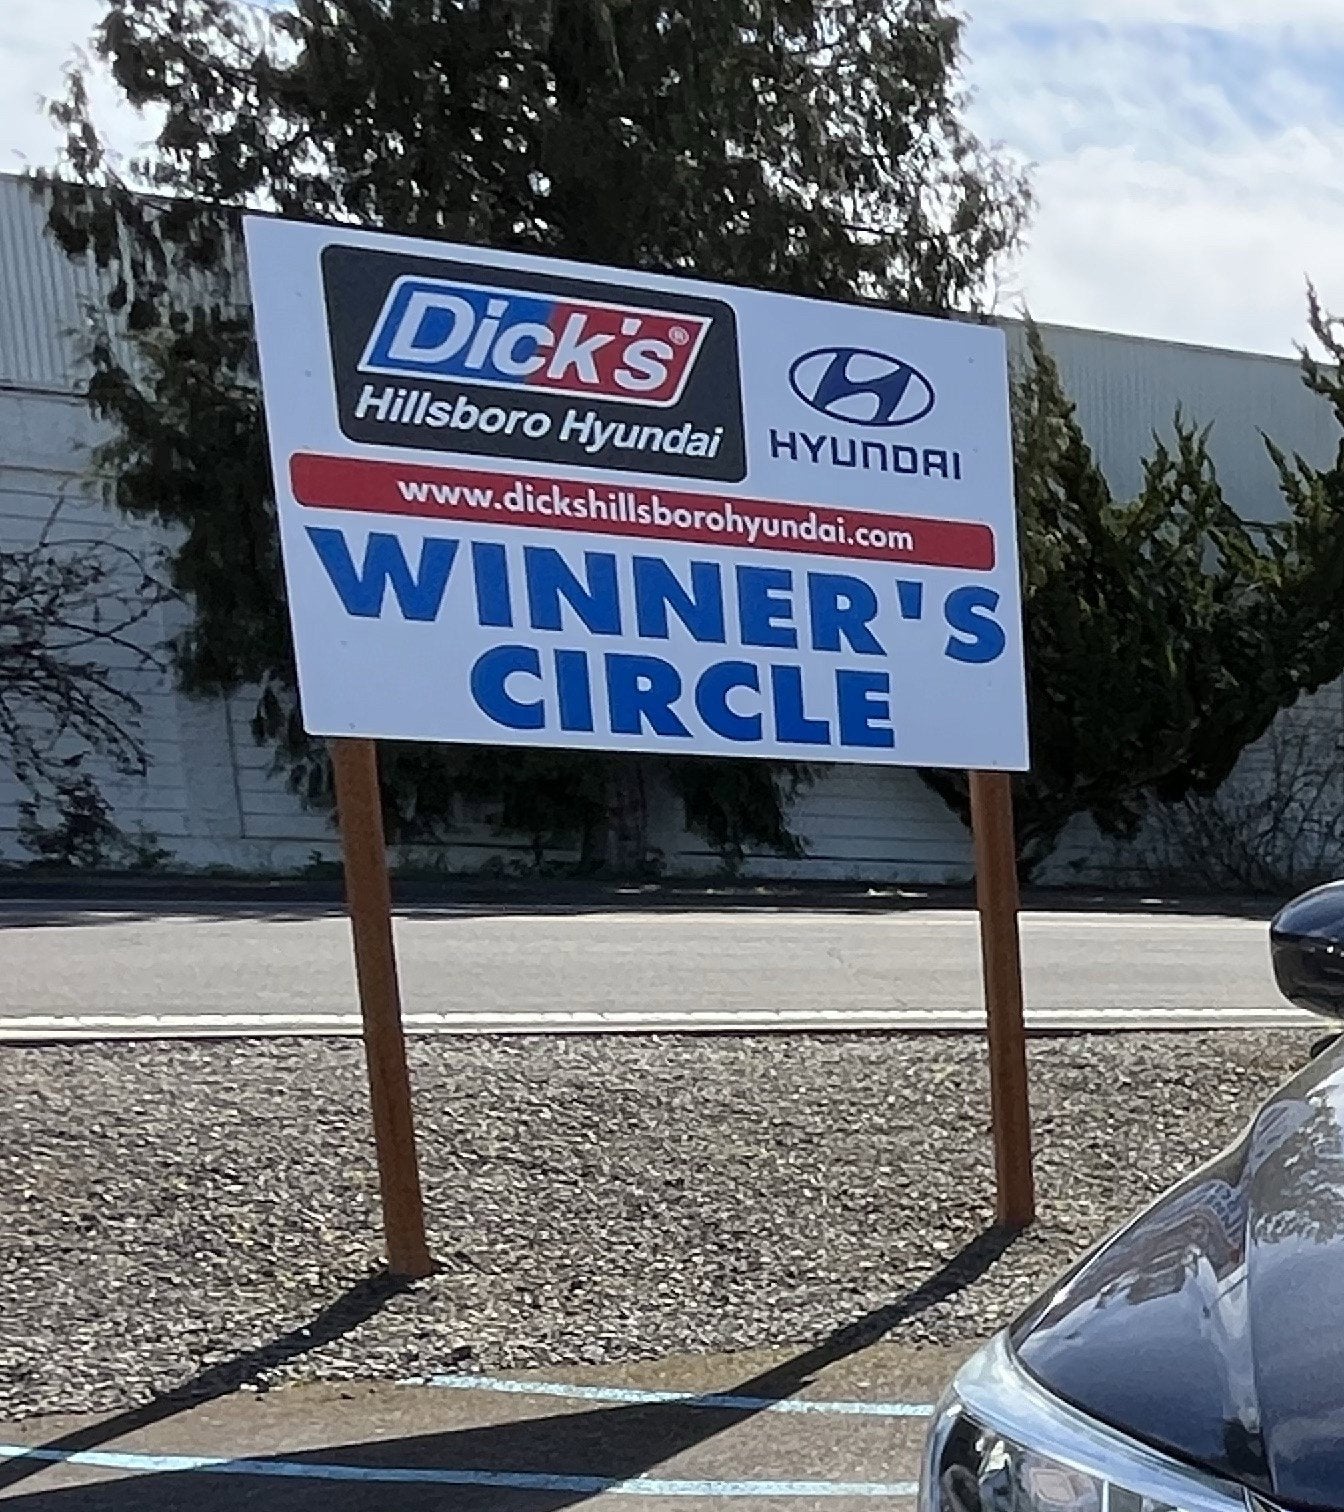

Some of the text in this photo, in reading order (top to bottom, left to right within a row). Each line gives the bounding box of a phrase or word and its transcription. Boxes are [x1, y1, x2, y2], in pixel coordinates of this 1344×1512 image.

[391, 290, 676, 392] Dick's
[355, 384, 723, 459] Hillsboro Hyundai
[769, 429, 962, 480] HYUNDAI
[398, 480, 914, 552] www.dickshillsborohyundai.com
[305, 526, 1006, 664] WINNER'S
[469, 644, 896, 749] CIRCLE
